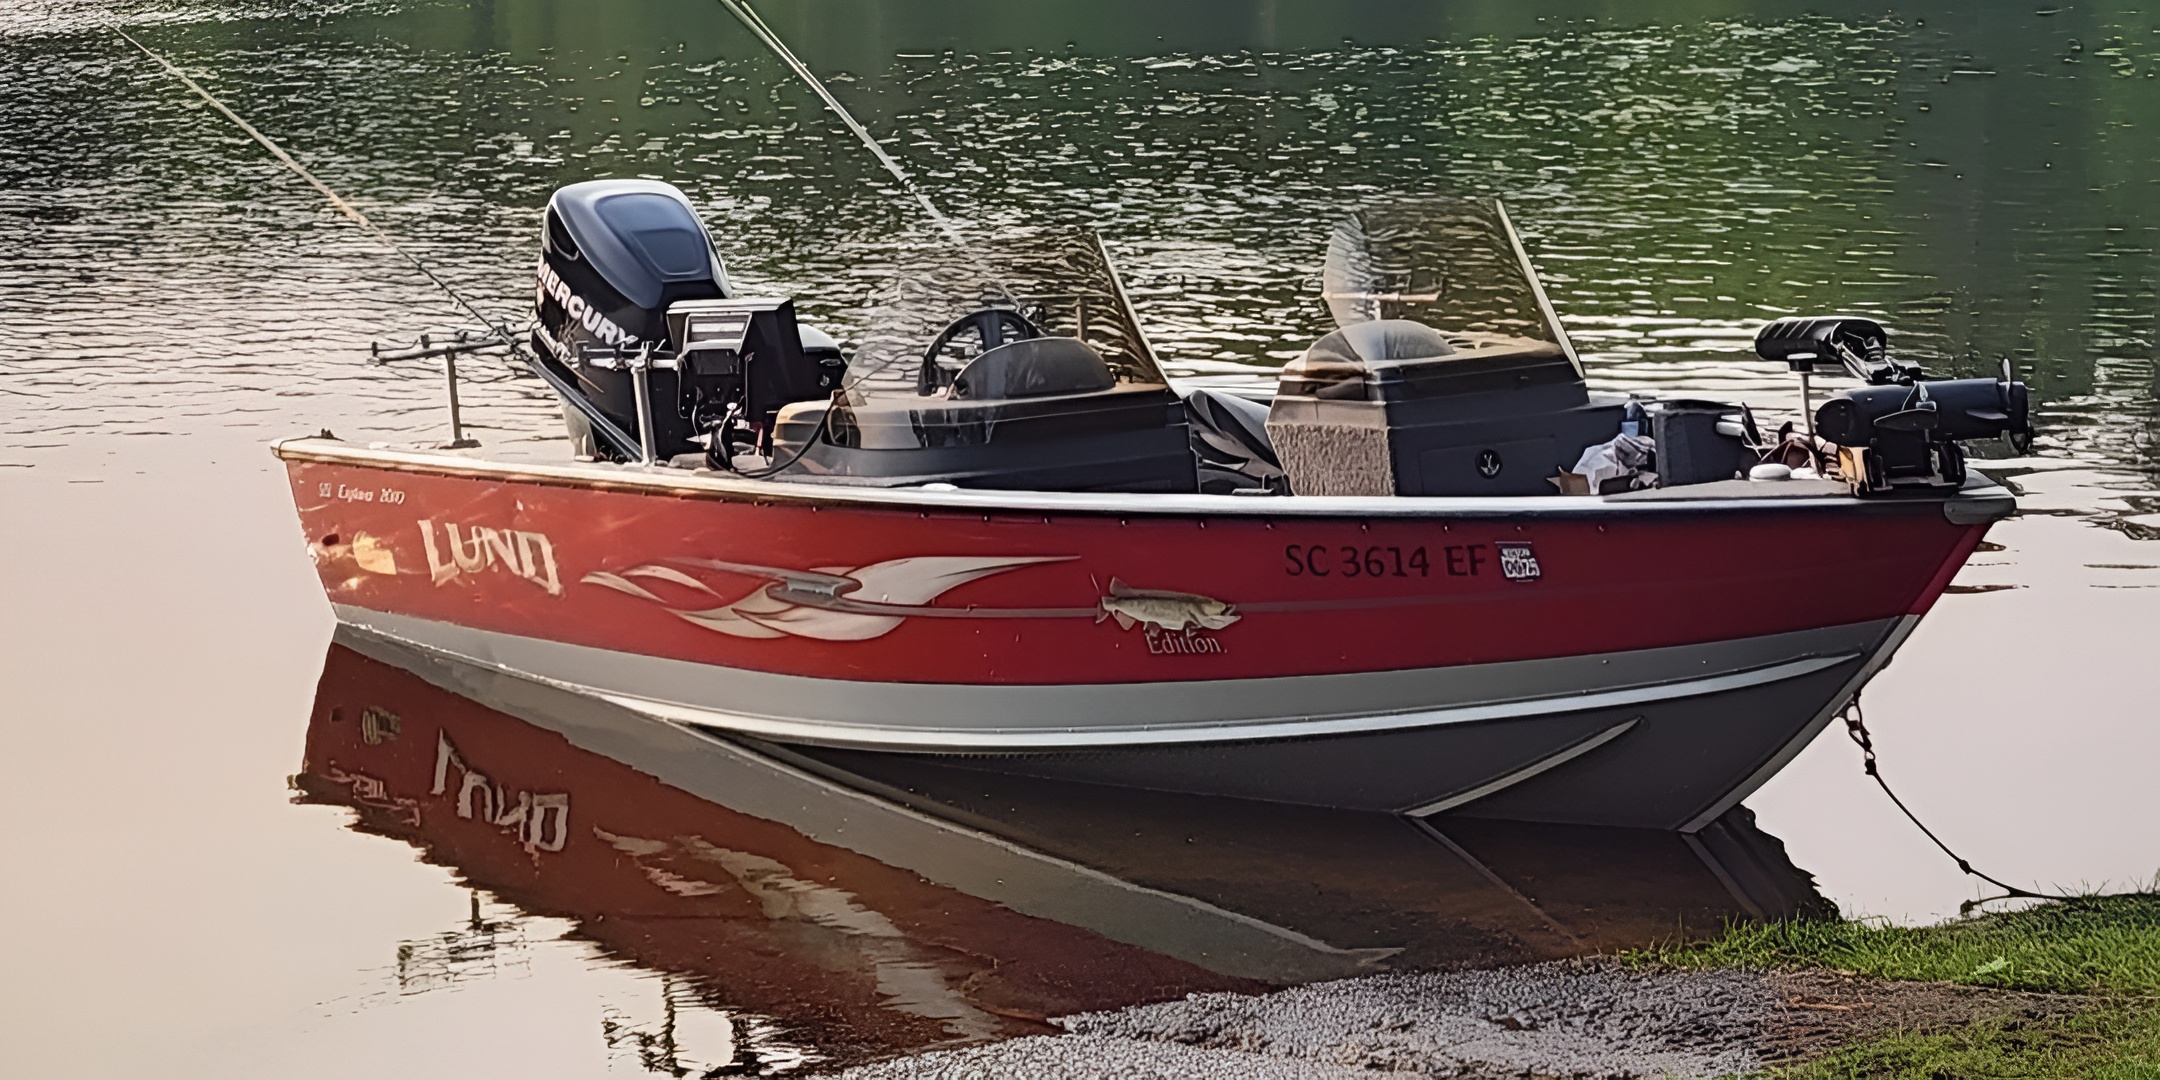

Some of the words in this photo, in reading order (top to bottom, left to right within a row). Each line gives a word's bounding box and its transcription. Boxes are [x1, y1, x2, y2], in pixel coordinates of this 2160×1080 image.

[537, 257, 638, 346] MERCURY
[417, 519, 563, 596] LUND
[1285, 544, 1330, 577] SC
[1341, 545, 1430, 578] 3614
[1445, 544, 1487, 577] EF
[1144, 632, 1220, 655] Edition
